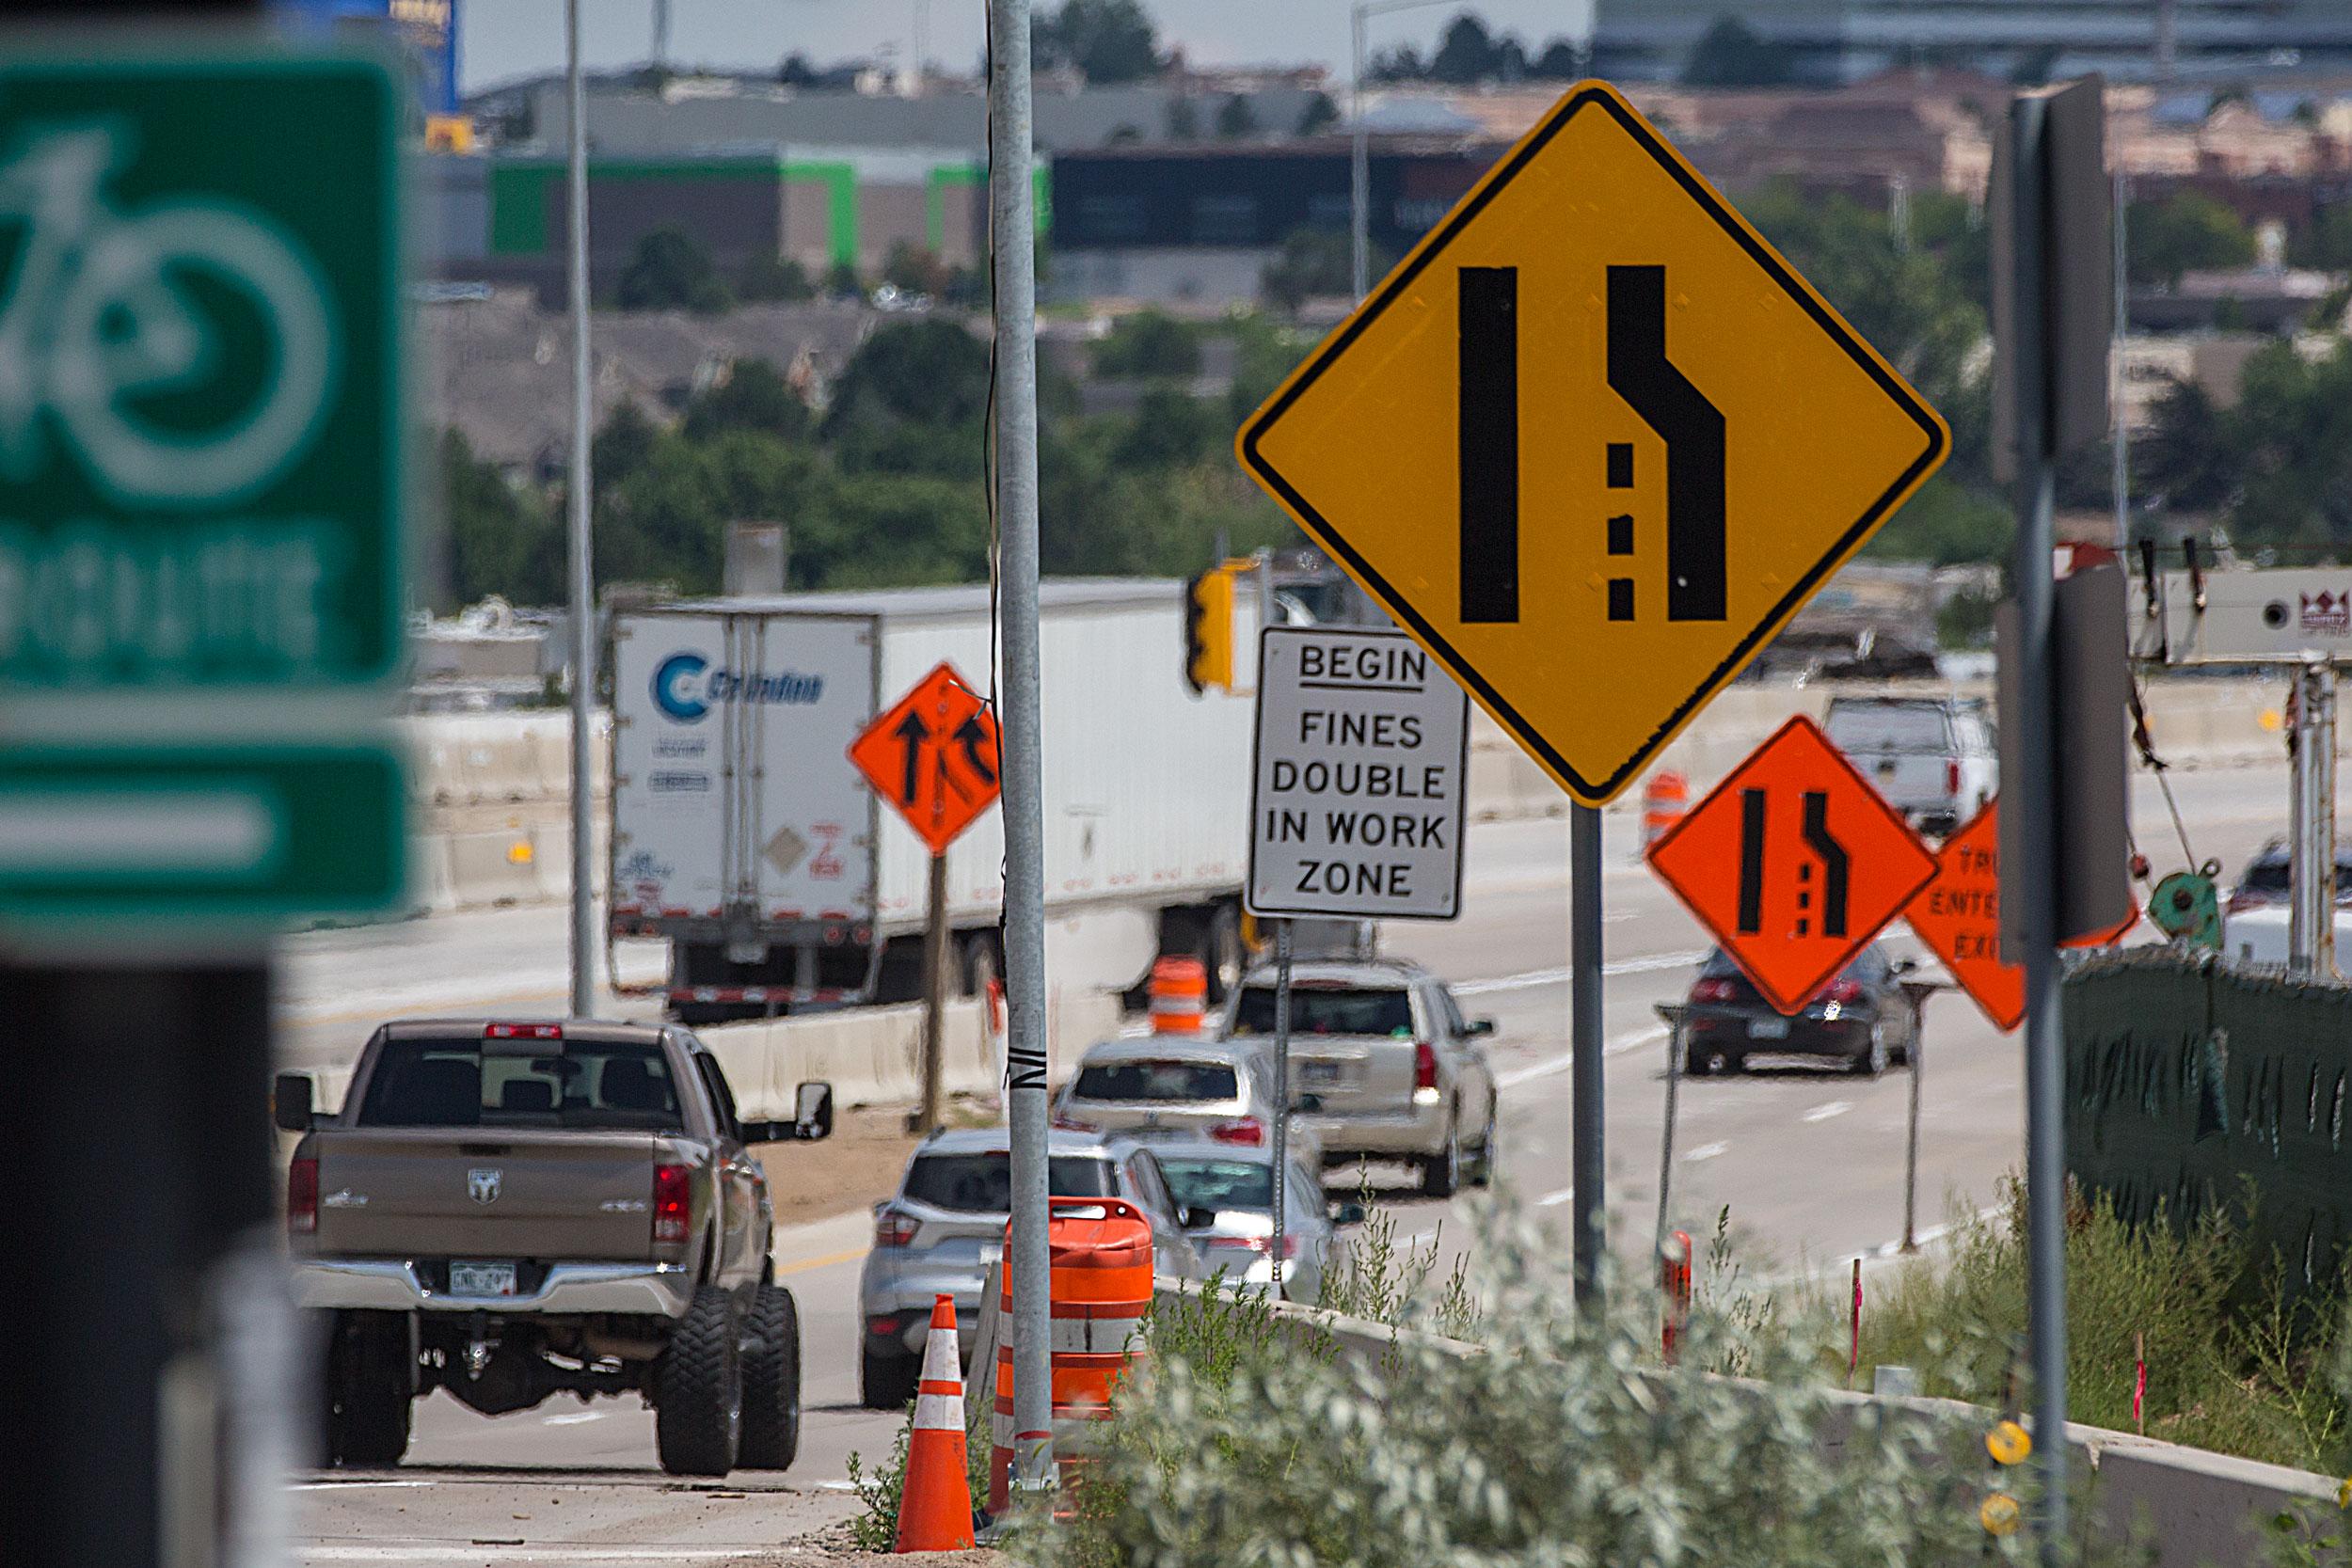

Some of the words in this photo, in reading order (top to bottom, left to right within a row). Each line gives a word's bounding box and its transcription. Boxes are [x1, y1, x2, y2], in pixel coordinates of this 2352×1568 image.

[1298, 644, 1426, 681] BEGIN
[1299, 711, 1422, 750] FINES
[1272, 760, 1445, 800] DOUBLE
[1266, 808, 1307, 844] IN
[1326, 812, 1446, 849] WORK
[1295, 861, 1412, 896] ZONE
